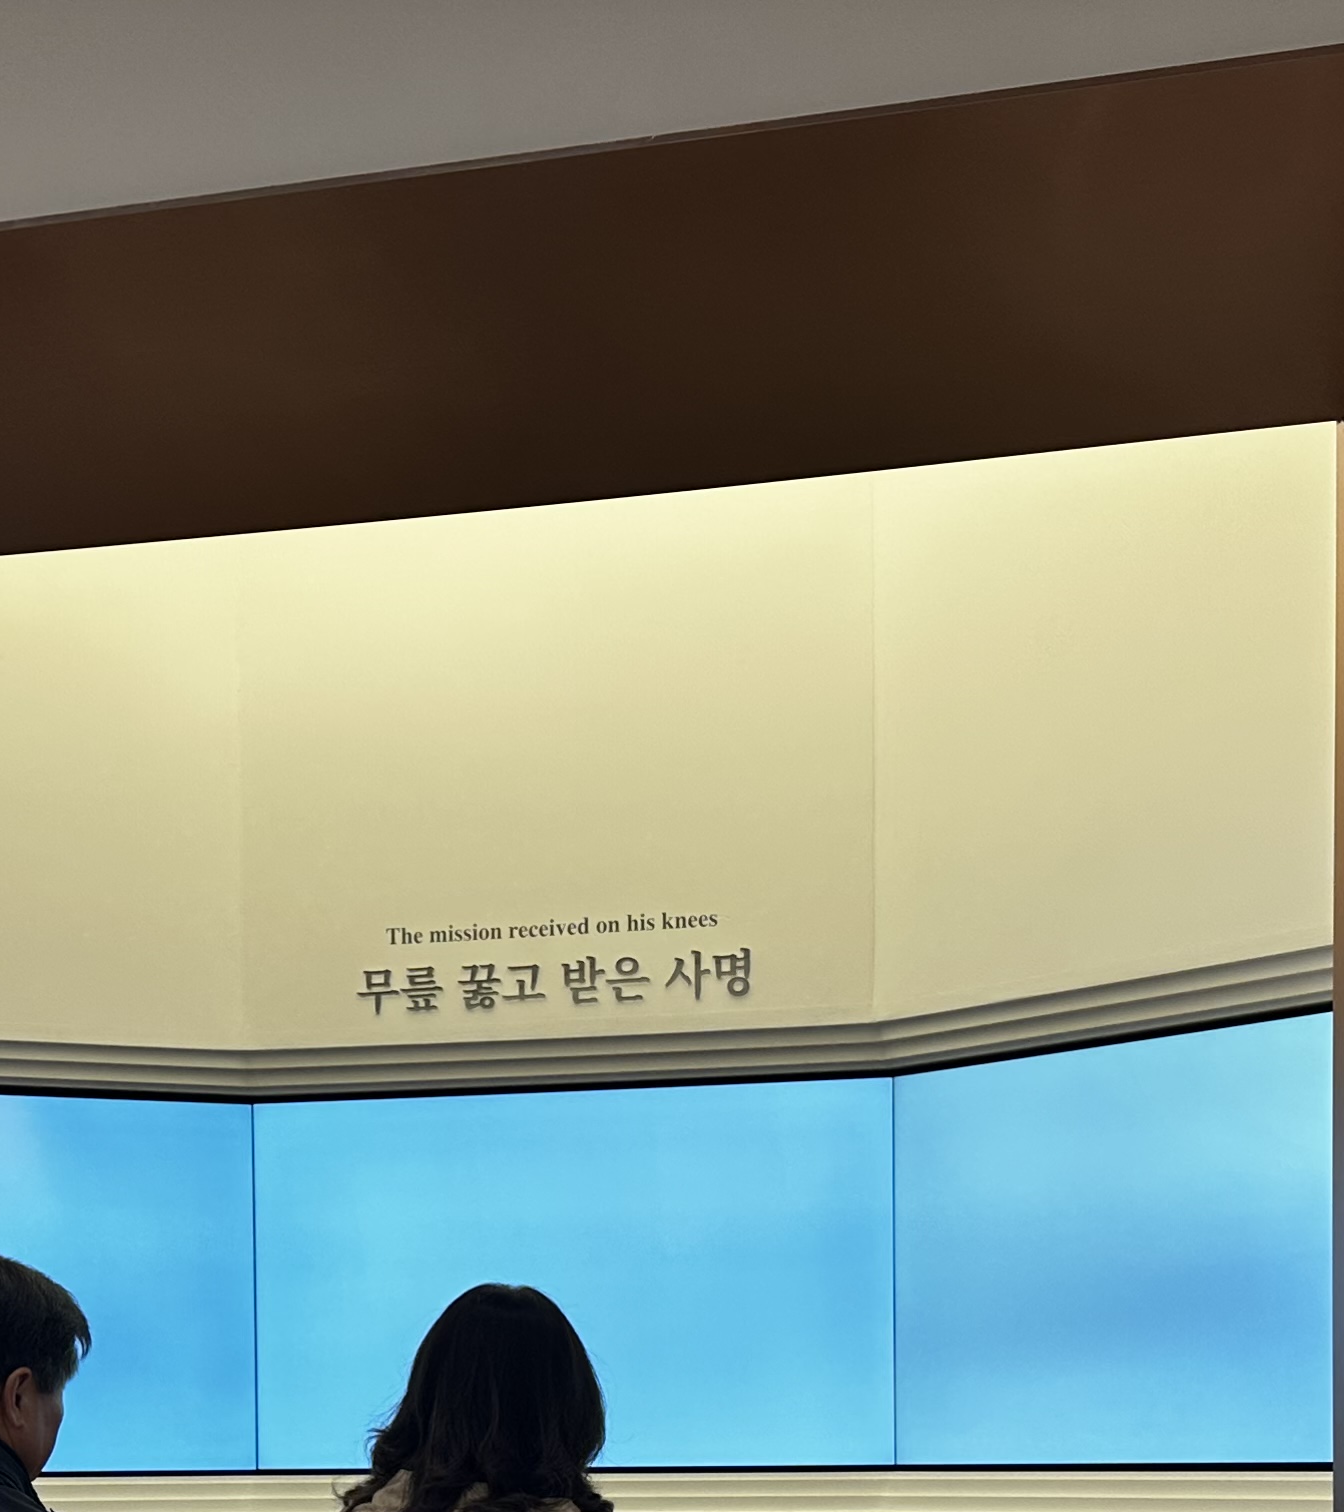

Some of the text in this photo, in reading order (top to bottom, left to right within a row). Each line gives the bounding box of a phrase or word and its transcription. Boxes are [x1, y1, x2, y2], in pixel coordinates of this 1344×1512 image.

[385, 911, 719, 946] The mission received on his knees
[356, 947, 752, 1016] 무릎 꿇고 받은 사명
